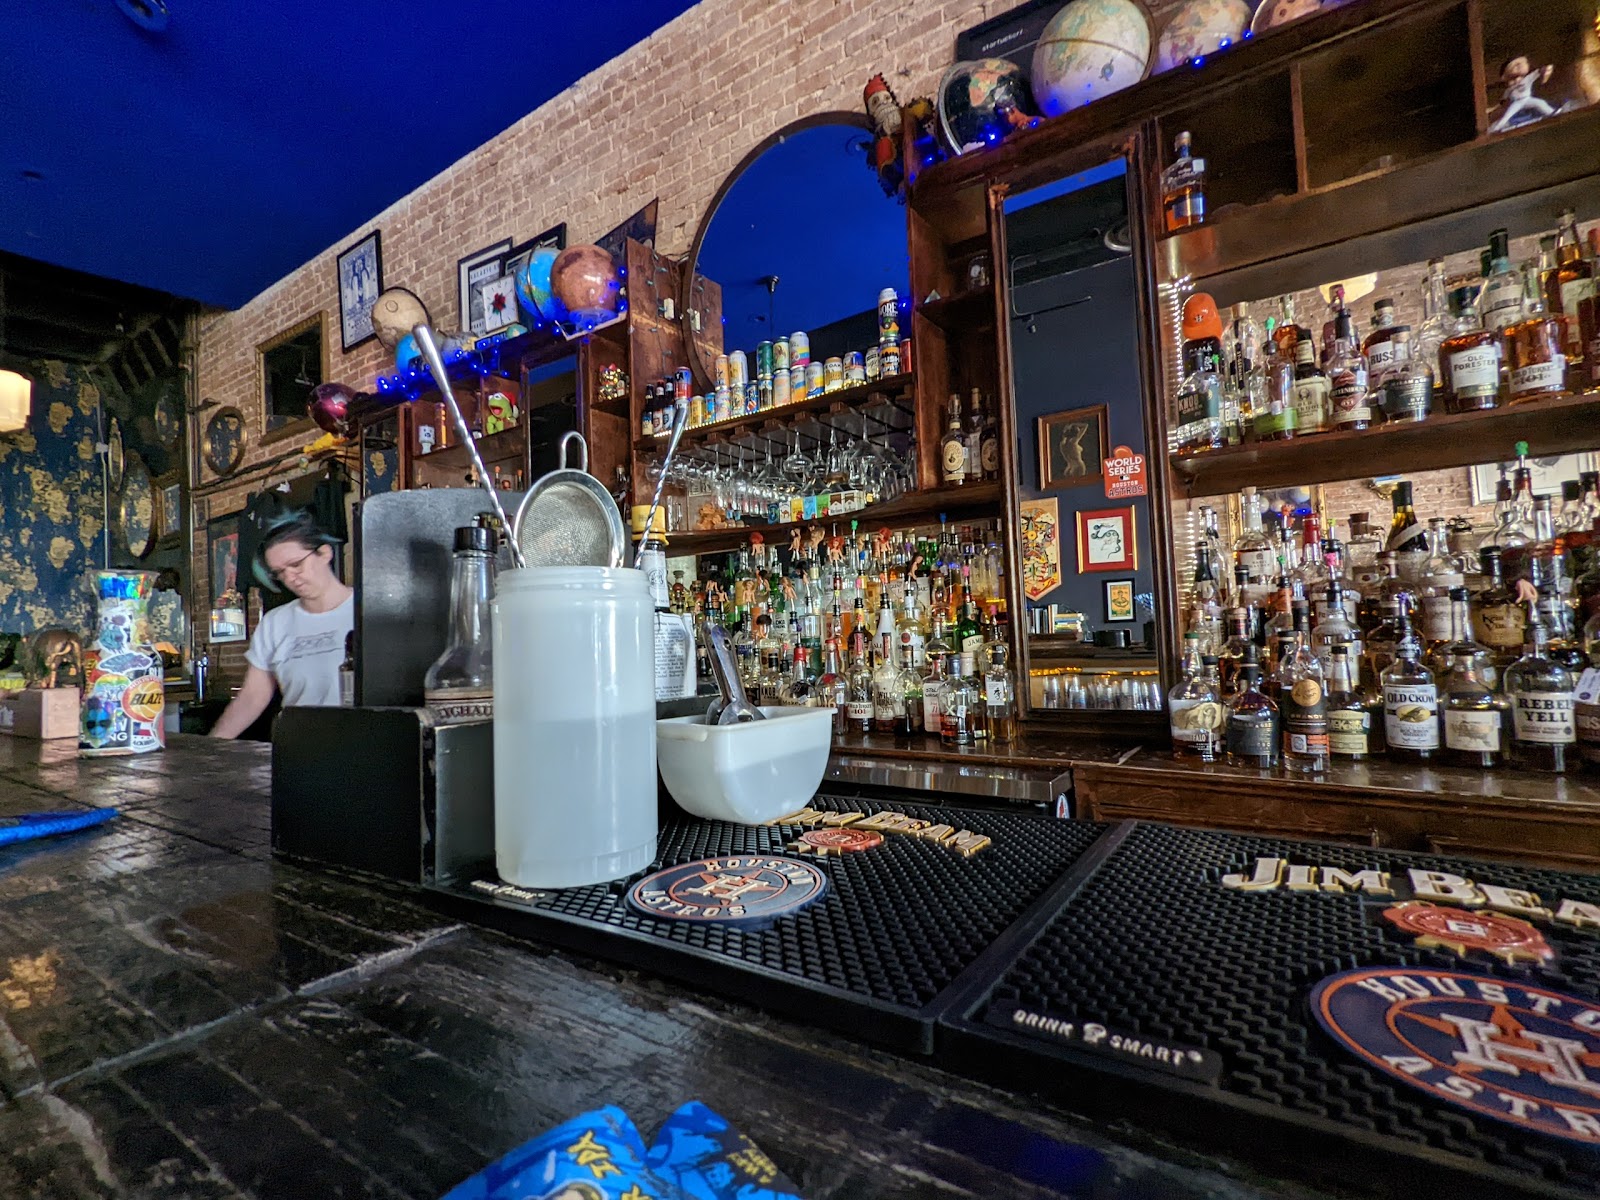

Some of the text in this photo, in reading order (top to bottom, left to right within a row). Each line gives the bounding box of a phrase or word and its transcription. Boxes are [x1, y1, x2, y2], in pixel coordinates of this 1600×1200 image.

[1467, 354, 1484, 362] OLD
[1453, 359, 1497, 372] FORESTER
[1105, 456, 1143, 469] WORLD
[1108, 464, 1141, 477] SERIES
[1111, 480, 1139, 488] HOUSTON
[1108, 485, 1144, 497] ASTROS
[1386, 692, 1435, 704] OLD CROW
[1524, 711, 1568, 723] YELL
[851, 811, 992, 857] BEAM
[703, 858, 816, 886] HOUSTON
[1221, 857, 1600, 927] JIM BEA
[641, 889, 746, 917] ASTROS
[1355, 973, 1600, 1035] HOUSTO
[1012, 1008, 1185, 1067] DRINK SMART
[1381, 1054, 1600, 1139] ASTR
